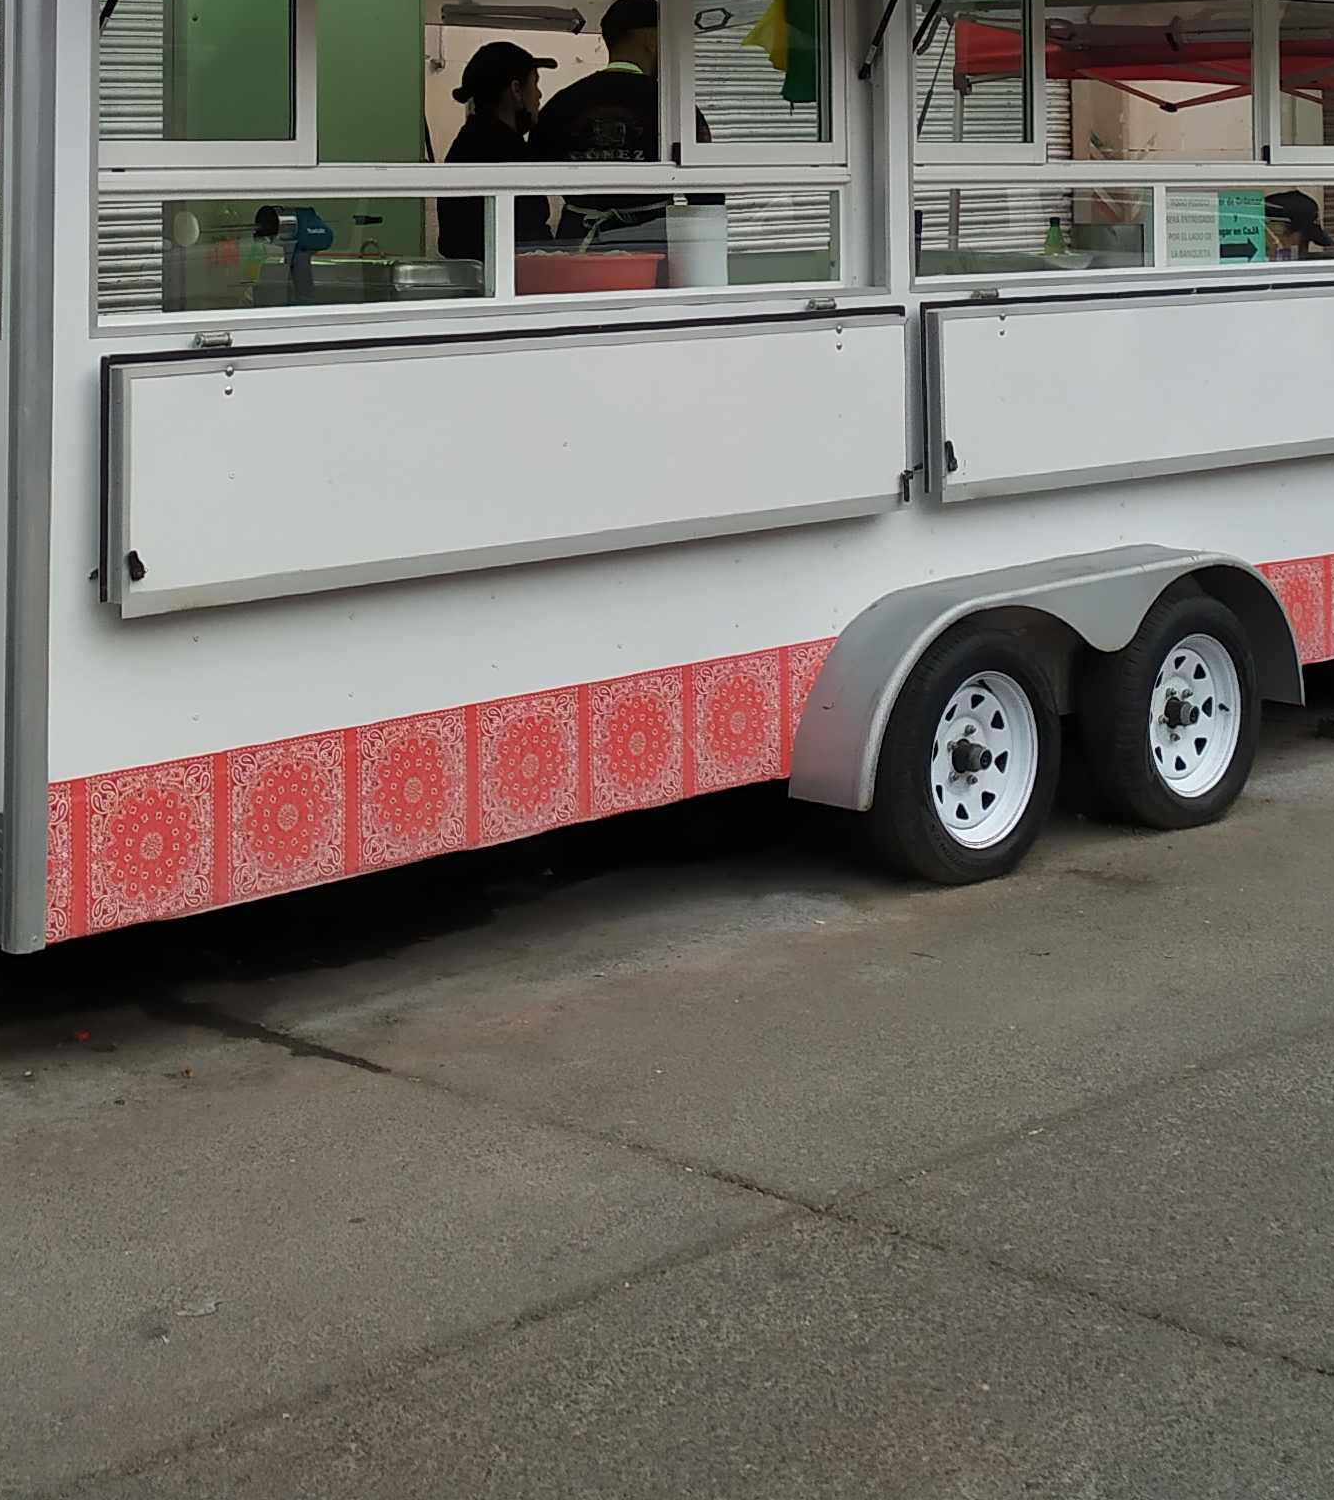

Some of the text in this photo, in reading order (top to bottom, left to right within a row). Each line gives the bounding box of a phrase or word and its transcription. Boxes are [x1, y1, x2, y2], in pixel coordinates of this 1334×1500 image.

[1181, 215, 1216, 224] ENTREGADO
[1168, 233, 1213, 241] POR EL LADO DE
[1171, 249, 1211, 259] LA BANQUETA
